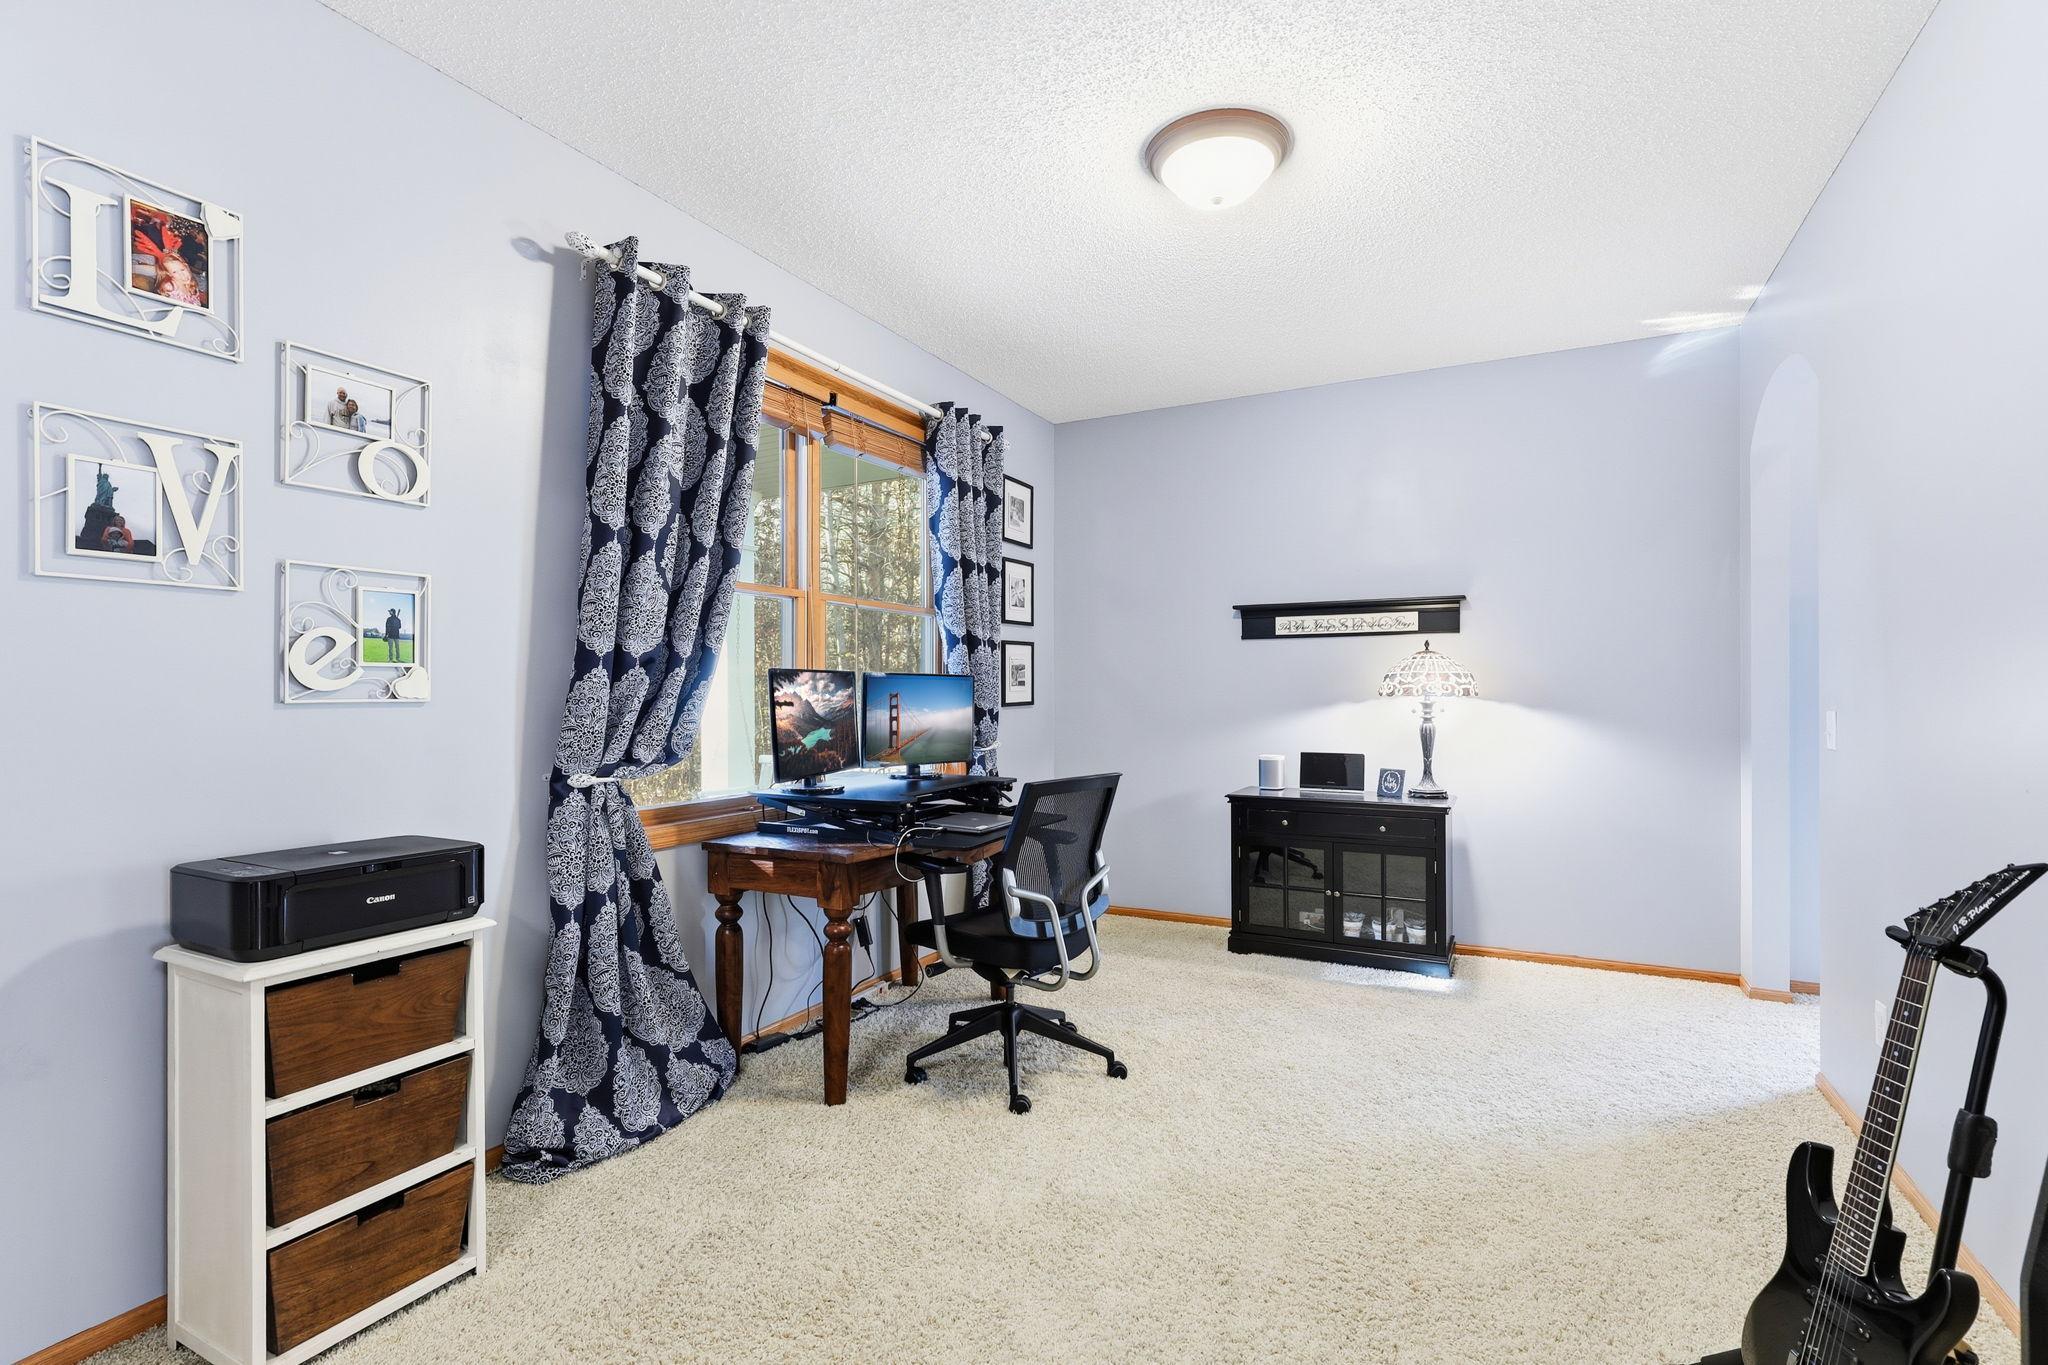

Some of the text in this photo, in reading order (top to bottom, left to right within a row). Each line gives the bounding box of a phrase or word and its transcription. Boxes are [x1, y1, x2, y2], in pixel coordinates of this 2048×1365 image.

[39, 175, 184, 338] L
[289, 627, 365, 691] e
[366, 893, 396, 904] Canon
